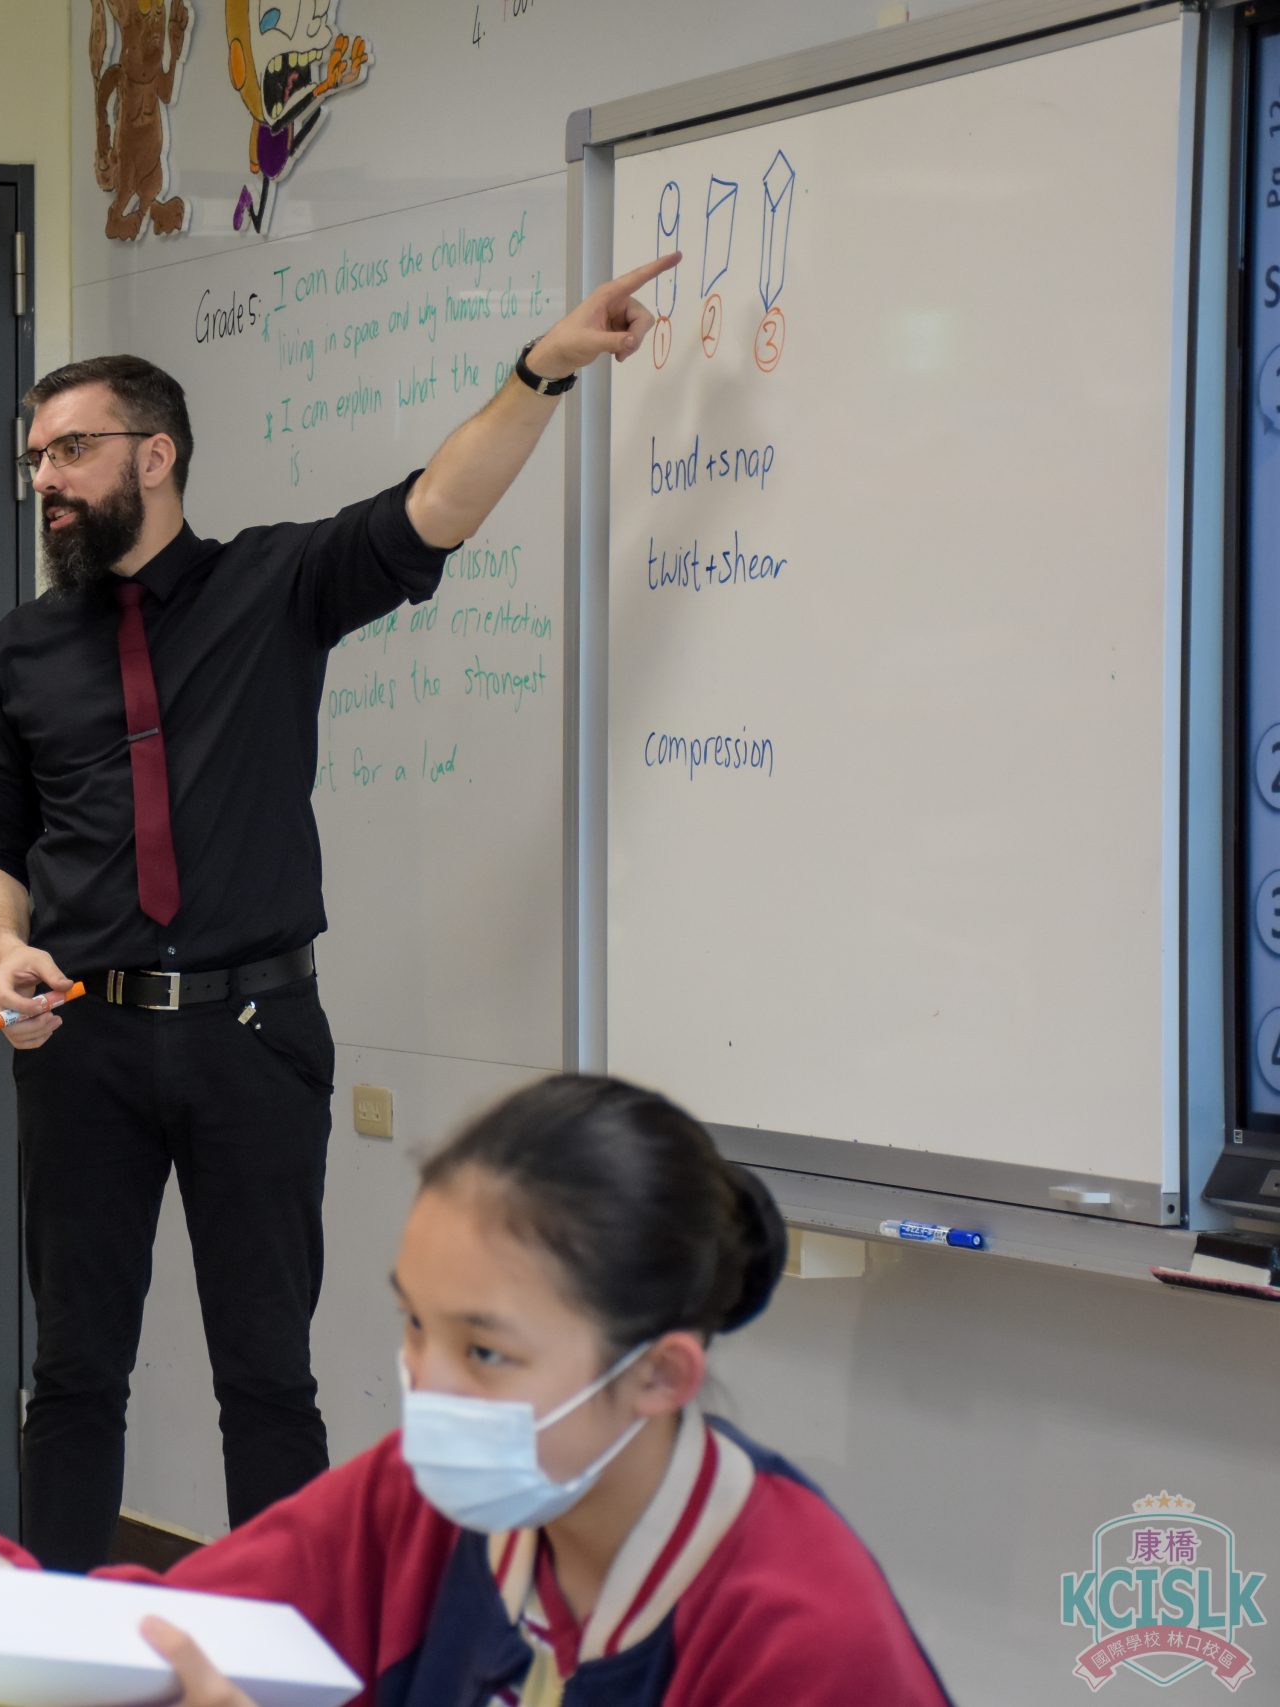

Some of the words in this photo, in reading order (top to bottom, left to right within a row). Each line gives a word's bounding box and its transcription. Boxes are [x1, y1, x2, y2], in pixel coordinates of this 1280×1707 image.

[274, 266, 291, 312] I
[295, 267, 328, 302] can
[335, 249, 389, 297] discuss
[399, 241, 423, 279] the
[431, 227, 495, 288] challenges
[507, 210, 527, 257] of
[278, 328, 314, 382] living
[324, 322, 338, 355] in
[343, 319, 380, 360] space
[388, 301, 410, 332] and
[418, 292, 438, 343] why
[445, 285, 491, 323] humans
[500, 274, 517, 319] do
[702, 305, 716, 342] 2
[756, 320, 779, 365] 3
[281, 398, 293, 433] I
[301, 400, 329, 431] can
[336, 376, 383, 432] explain
[398, 356, 438, 408] what
[451, 352, 480, 394] the
[410, 596, 439, 632] and
[327, 672, 397, 741] provides
[411, 659, 441, 703] the
[464, 653, 547, 713] strongest
[352, 746, 383, 786] for
[394, 764, 407, 781] a
[645, 726, 775, 782] compression
